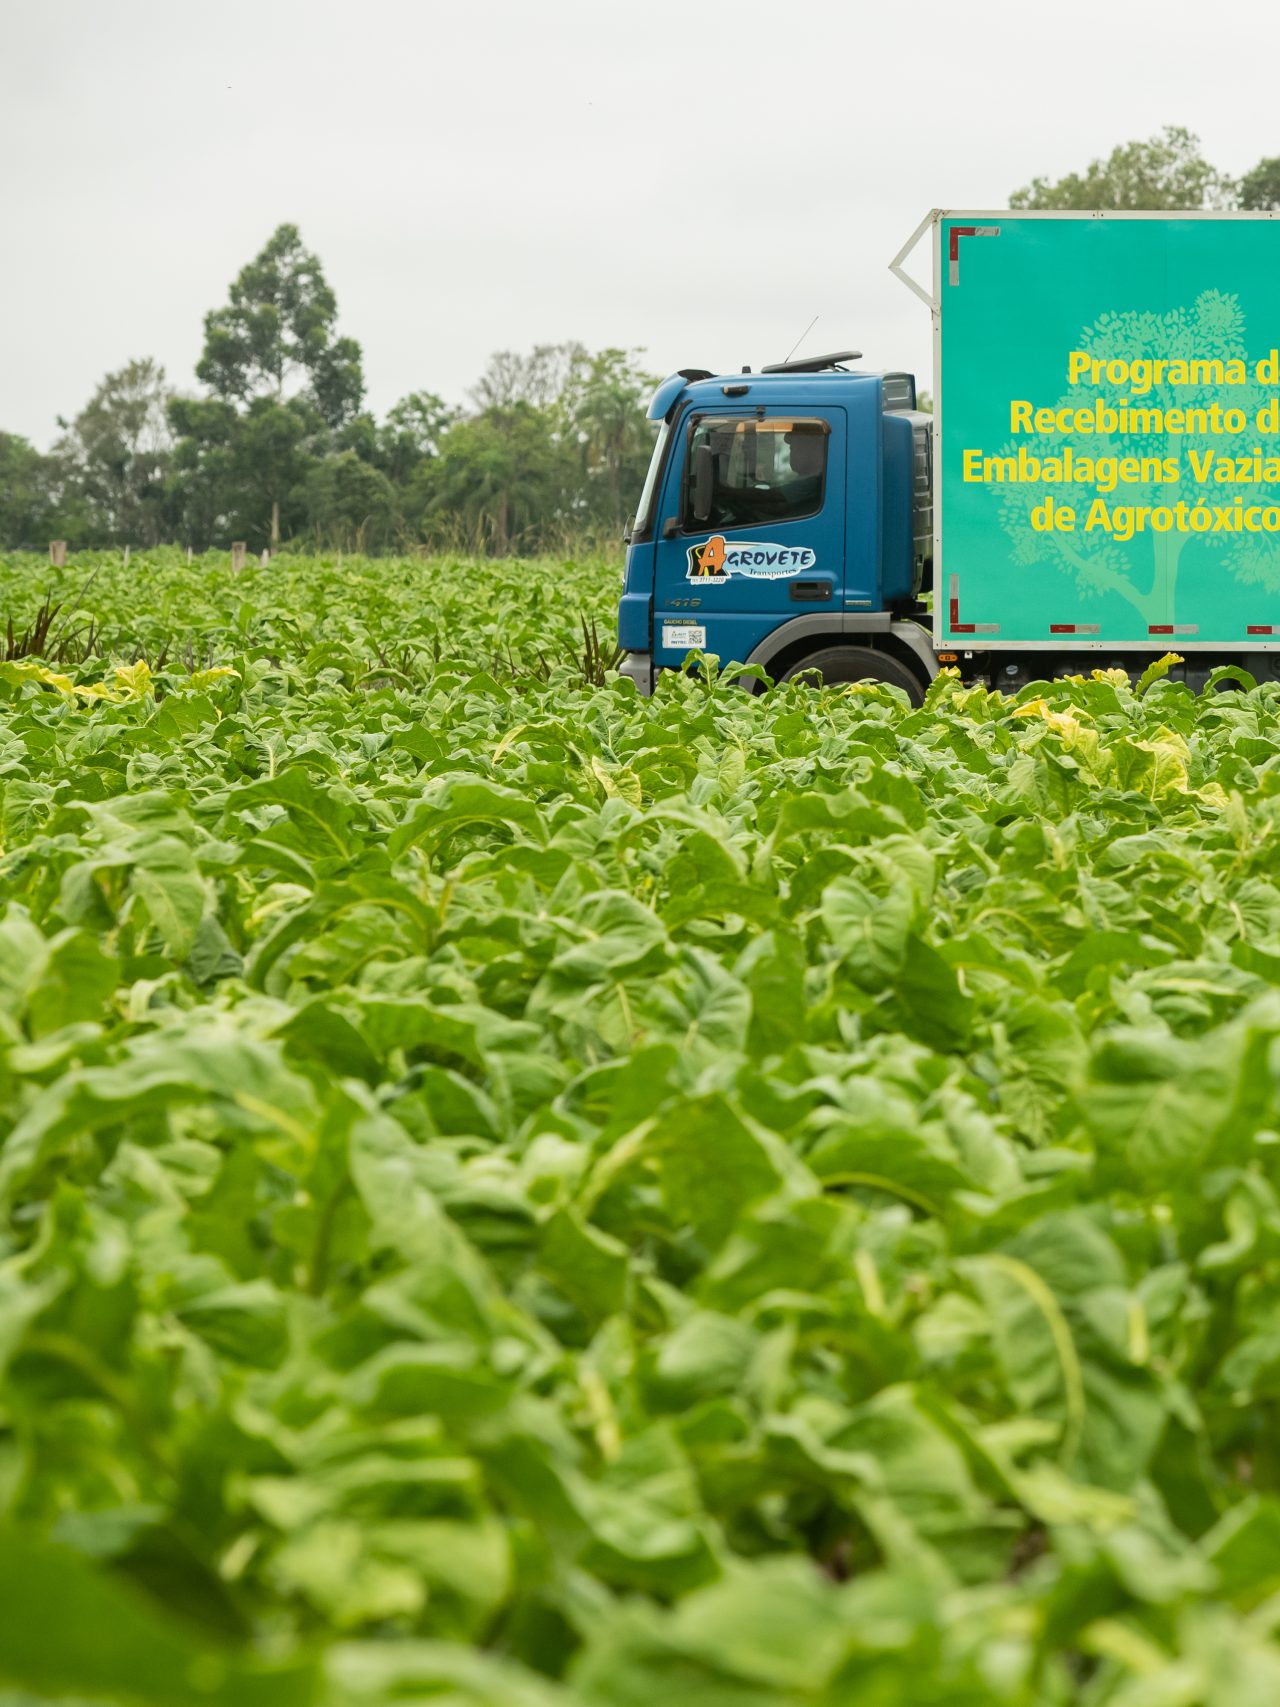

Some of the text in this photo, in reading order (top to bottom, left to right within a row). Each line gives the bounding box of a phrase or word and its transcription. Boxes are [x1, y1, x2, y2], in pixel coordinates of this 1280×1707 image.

[1069, 351, 1246, 394] Programa
[1010, 398, 1246, 434] Recebimento
[963, 447, 1180, 492] Embalagens
[1030, 496, 1075, 532] de
